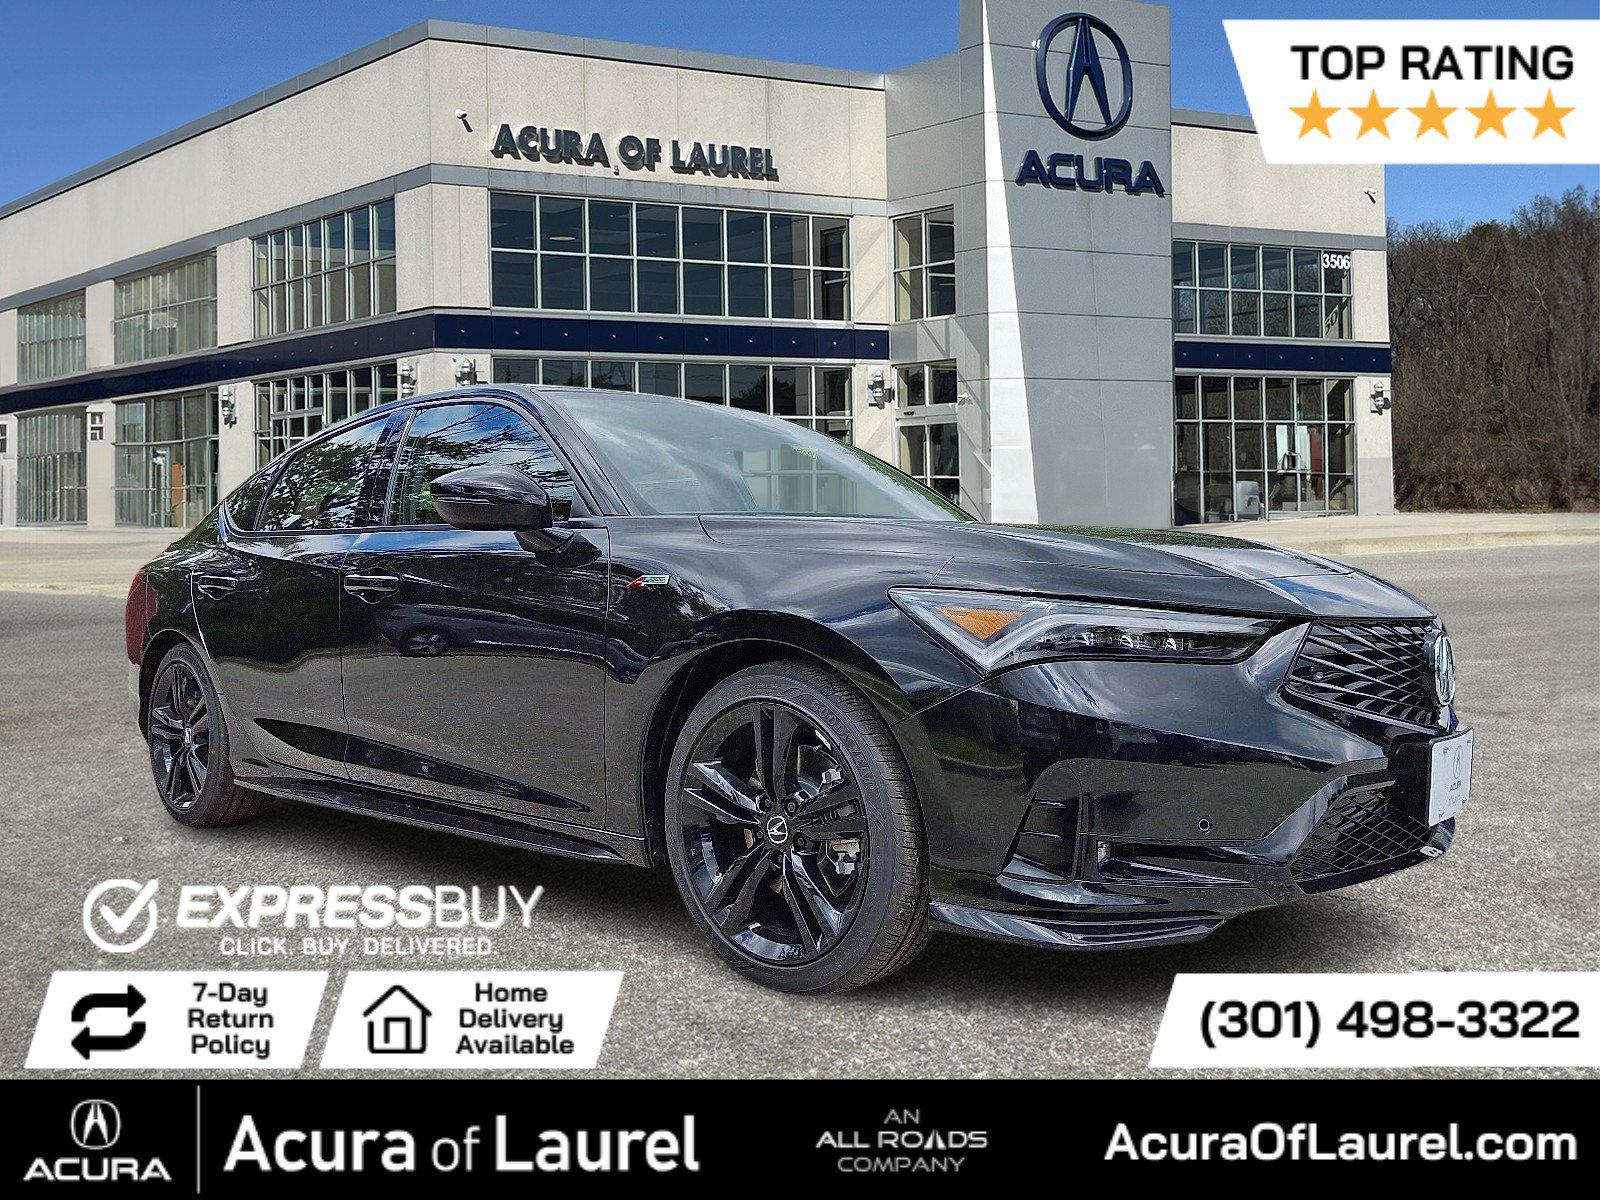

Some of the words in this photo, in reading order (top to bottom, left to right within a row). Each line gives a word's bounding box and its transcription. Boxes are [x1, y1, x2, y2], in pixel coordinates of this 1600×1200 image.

[490, 123, 611, 168] ACURA
[617, 135, 662, 172] OF
[670, 139, 779, 182] LAUREL
[1015, 150, 1166, 198] ACURA
[1322, 253, 1351, 270] 3506
